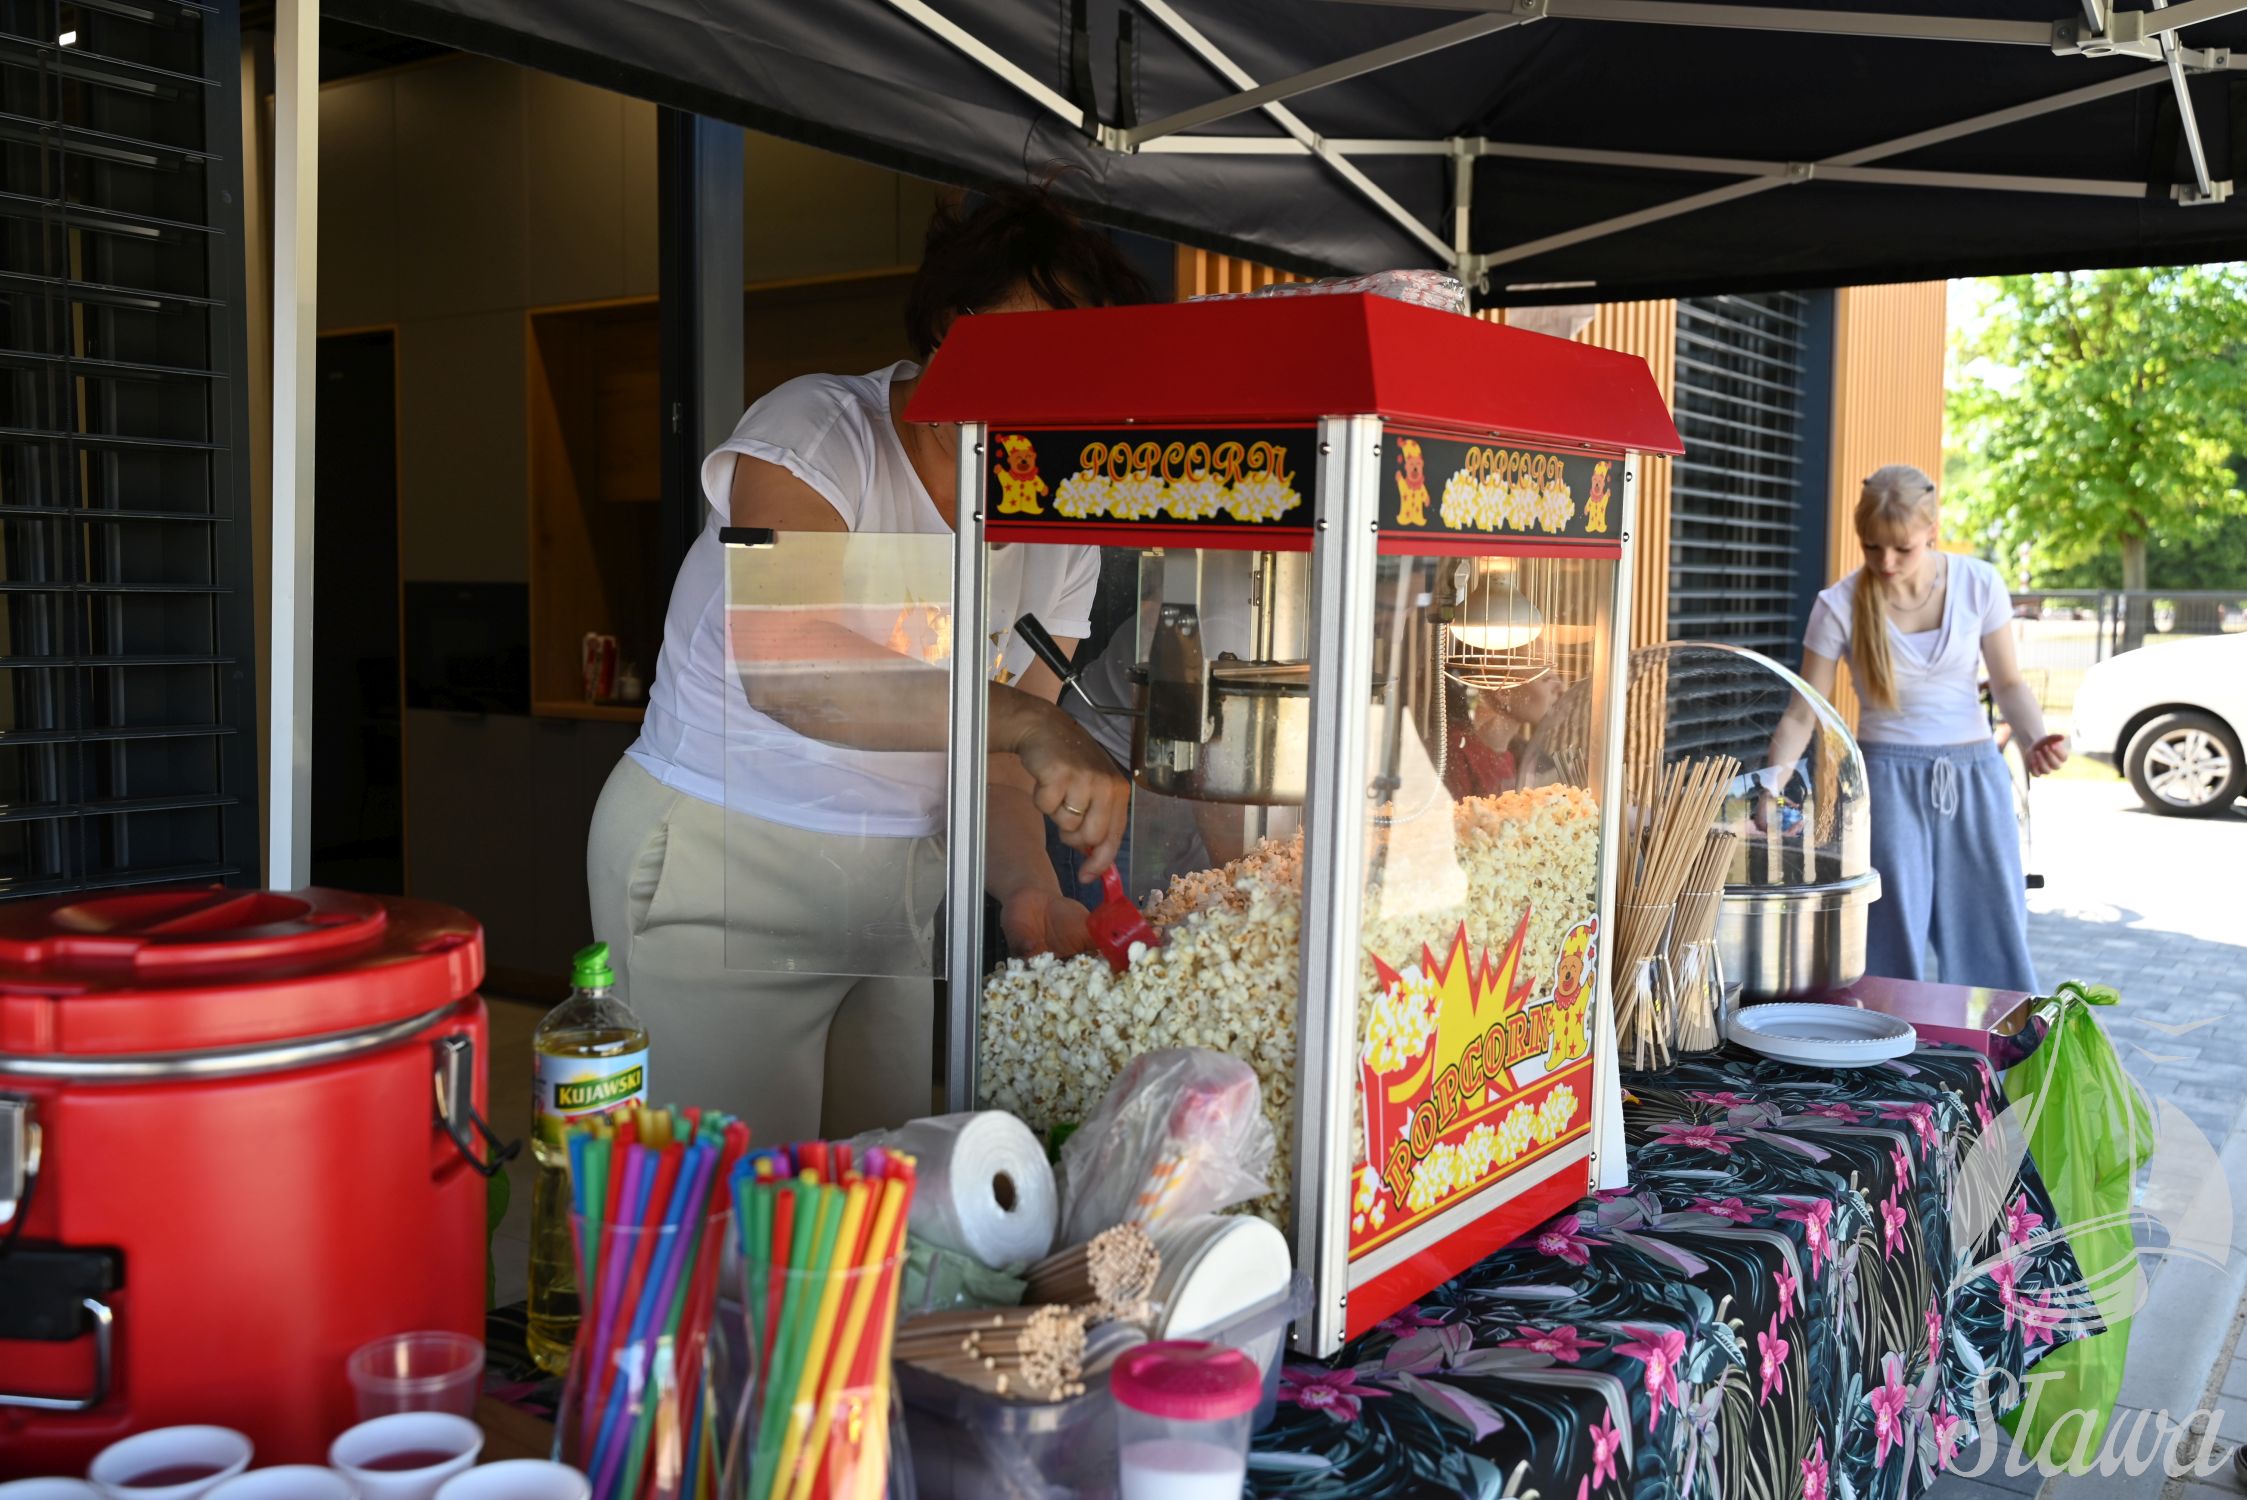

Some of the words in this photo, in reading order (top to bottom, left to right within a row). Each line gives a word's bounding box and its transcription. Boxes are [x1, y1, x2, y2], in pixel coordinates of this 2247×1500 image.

[1080, 441, 1296, 483] POPCORN
[1465, 446, 1565, 492] POPCORN
[559, 1068, 642, 1106] KUJAWSKI
[1383, 1001, 1557, 1211] POPCORN
